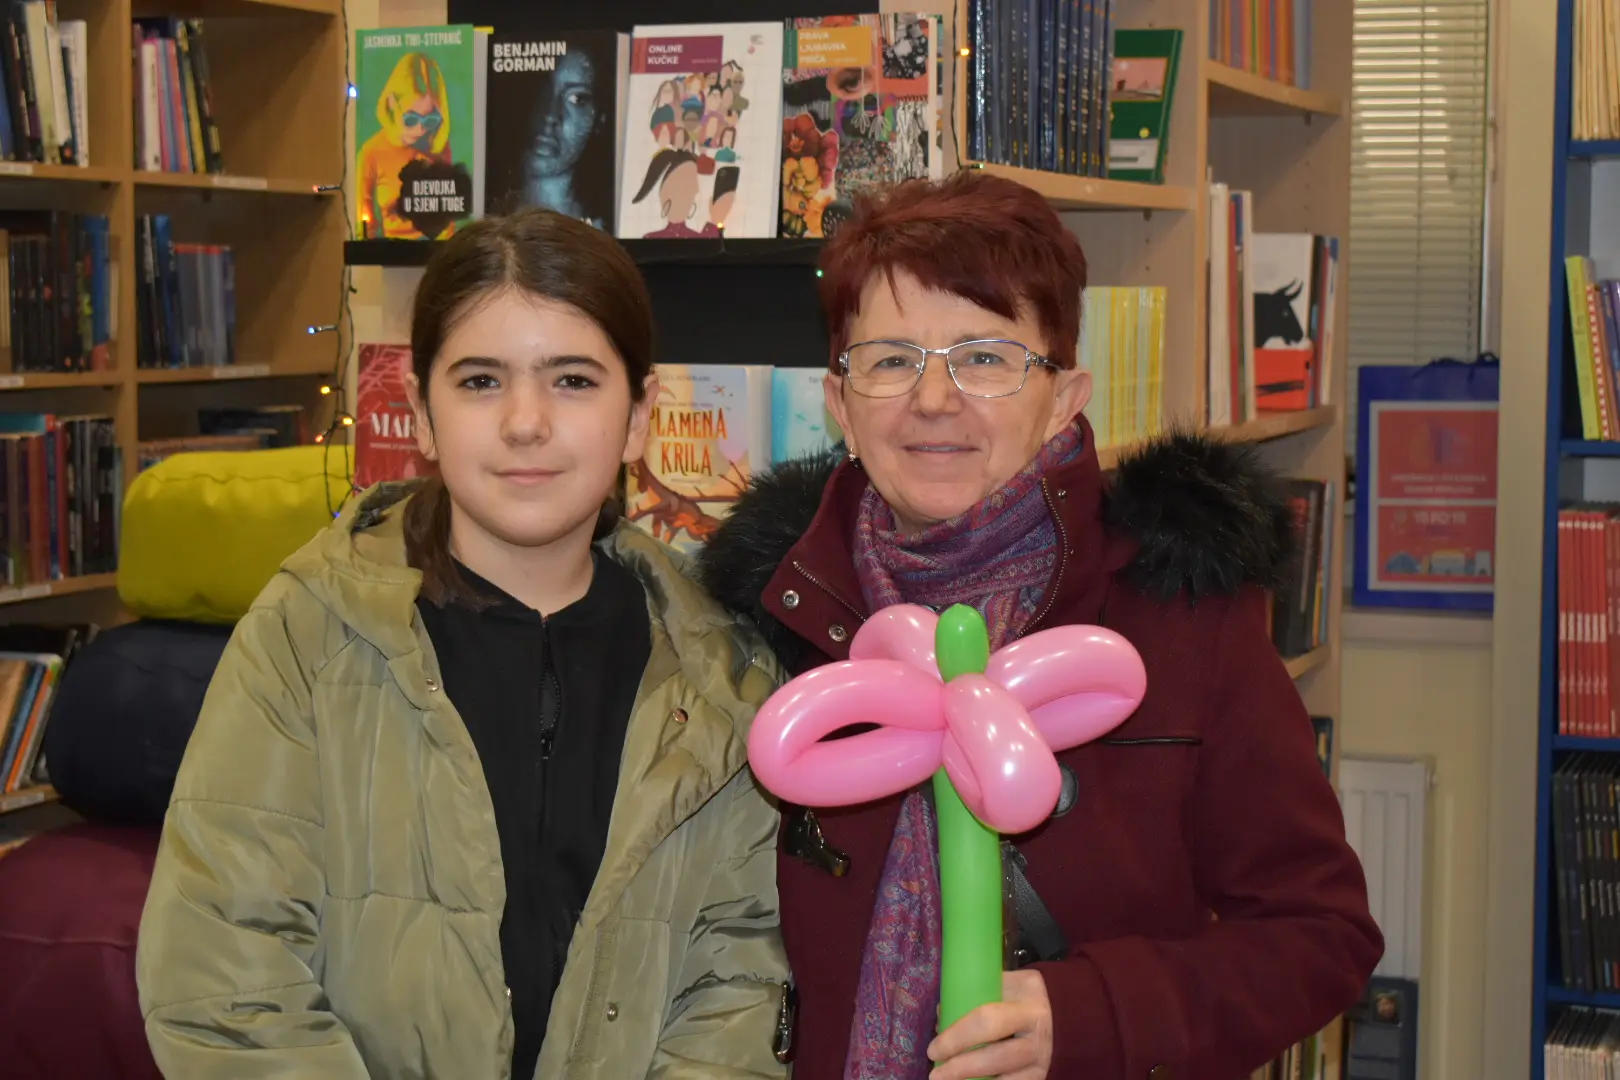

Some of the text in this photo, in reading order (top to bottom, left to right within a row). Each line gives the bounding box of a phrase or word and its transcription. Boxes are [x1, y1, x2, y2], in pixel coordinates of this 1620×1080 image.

[493, 41, 567, 58] BENJAMIN
[648, 44, 683, 54] ONLINE
[493, 57, 556, 73] GORMAN
[647, 54, 679, 65] KUČKE
[412, 179, 457, 196] DJEVOJKA
[404, 197, 412, 213] U
[413, 196, 439, 213] SJENI
[661, 442, 713, 477] KRILA
